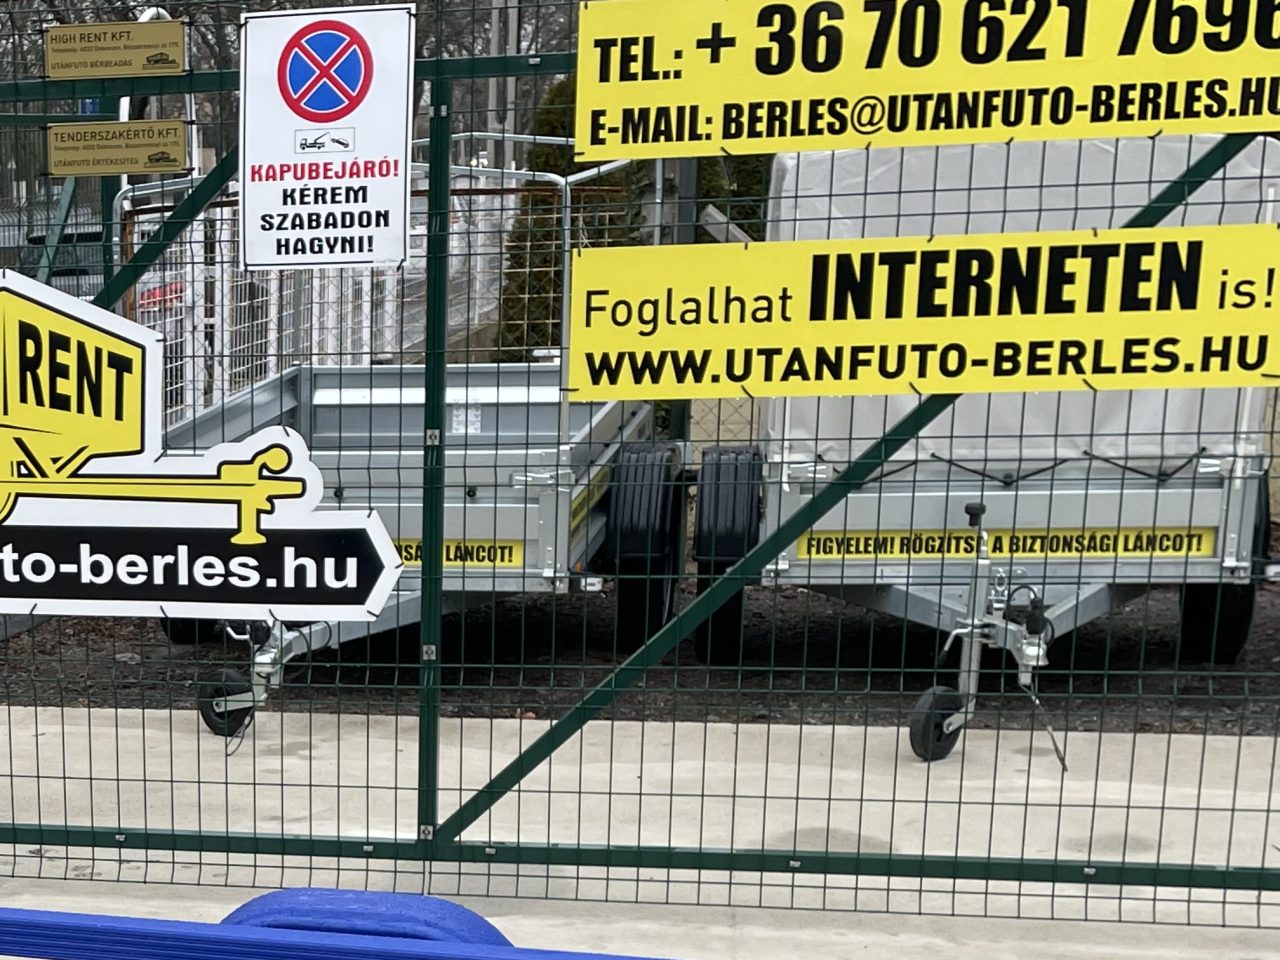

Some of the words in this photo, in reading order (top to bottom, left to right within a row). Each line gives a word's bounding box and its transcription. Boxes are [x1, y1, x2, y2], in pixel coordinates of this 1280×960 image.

[50, 34, 77, 44] HIGH
[80, 32, 109, 43] RENT
[111, 31, 134, 42] KFT.
[593, 35, 683, 83] TEL.:
[755, 1, 845, 76] 36
[864, 0, 942, 70] 70
[960, 0, 1088, 66] 621
[158, 128, 181, 139] KFT.
[590, 106, 713, 146] E-MAIL:
[250, 155, 400, 182] KAPUBEJÁRÓ!
[282, 184, 368, 206] KÉREM
[260, 210, 390, 232] SZABADON
[276, 235, 374, 256] HAGYNI!
[585, 286, 793, 337] Foglalhat
[809, 240, 1203, 321] INTERNETEN
[1218, 267, 1276, 310] is!
[18, 319, 133, 422] RENT
[585, 335, 1269, 386] WWW.UTANFUTO-BERLES.HU
[445, 542, 514, 563] LÁNCOT!
[806, 537, 895, 555] FIGYELEM!
[992, 536, 1004, 553] A
[1009, 531, 1119, 554] BIZTONSÁGI
[1123, 531, 1203, 552] LÁNCOT!
